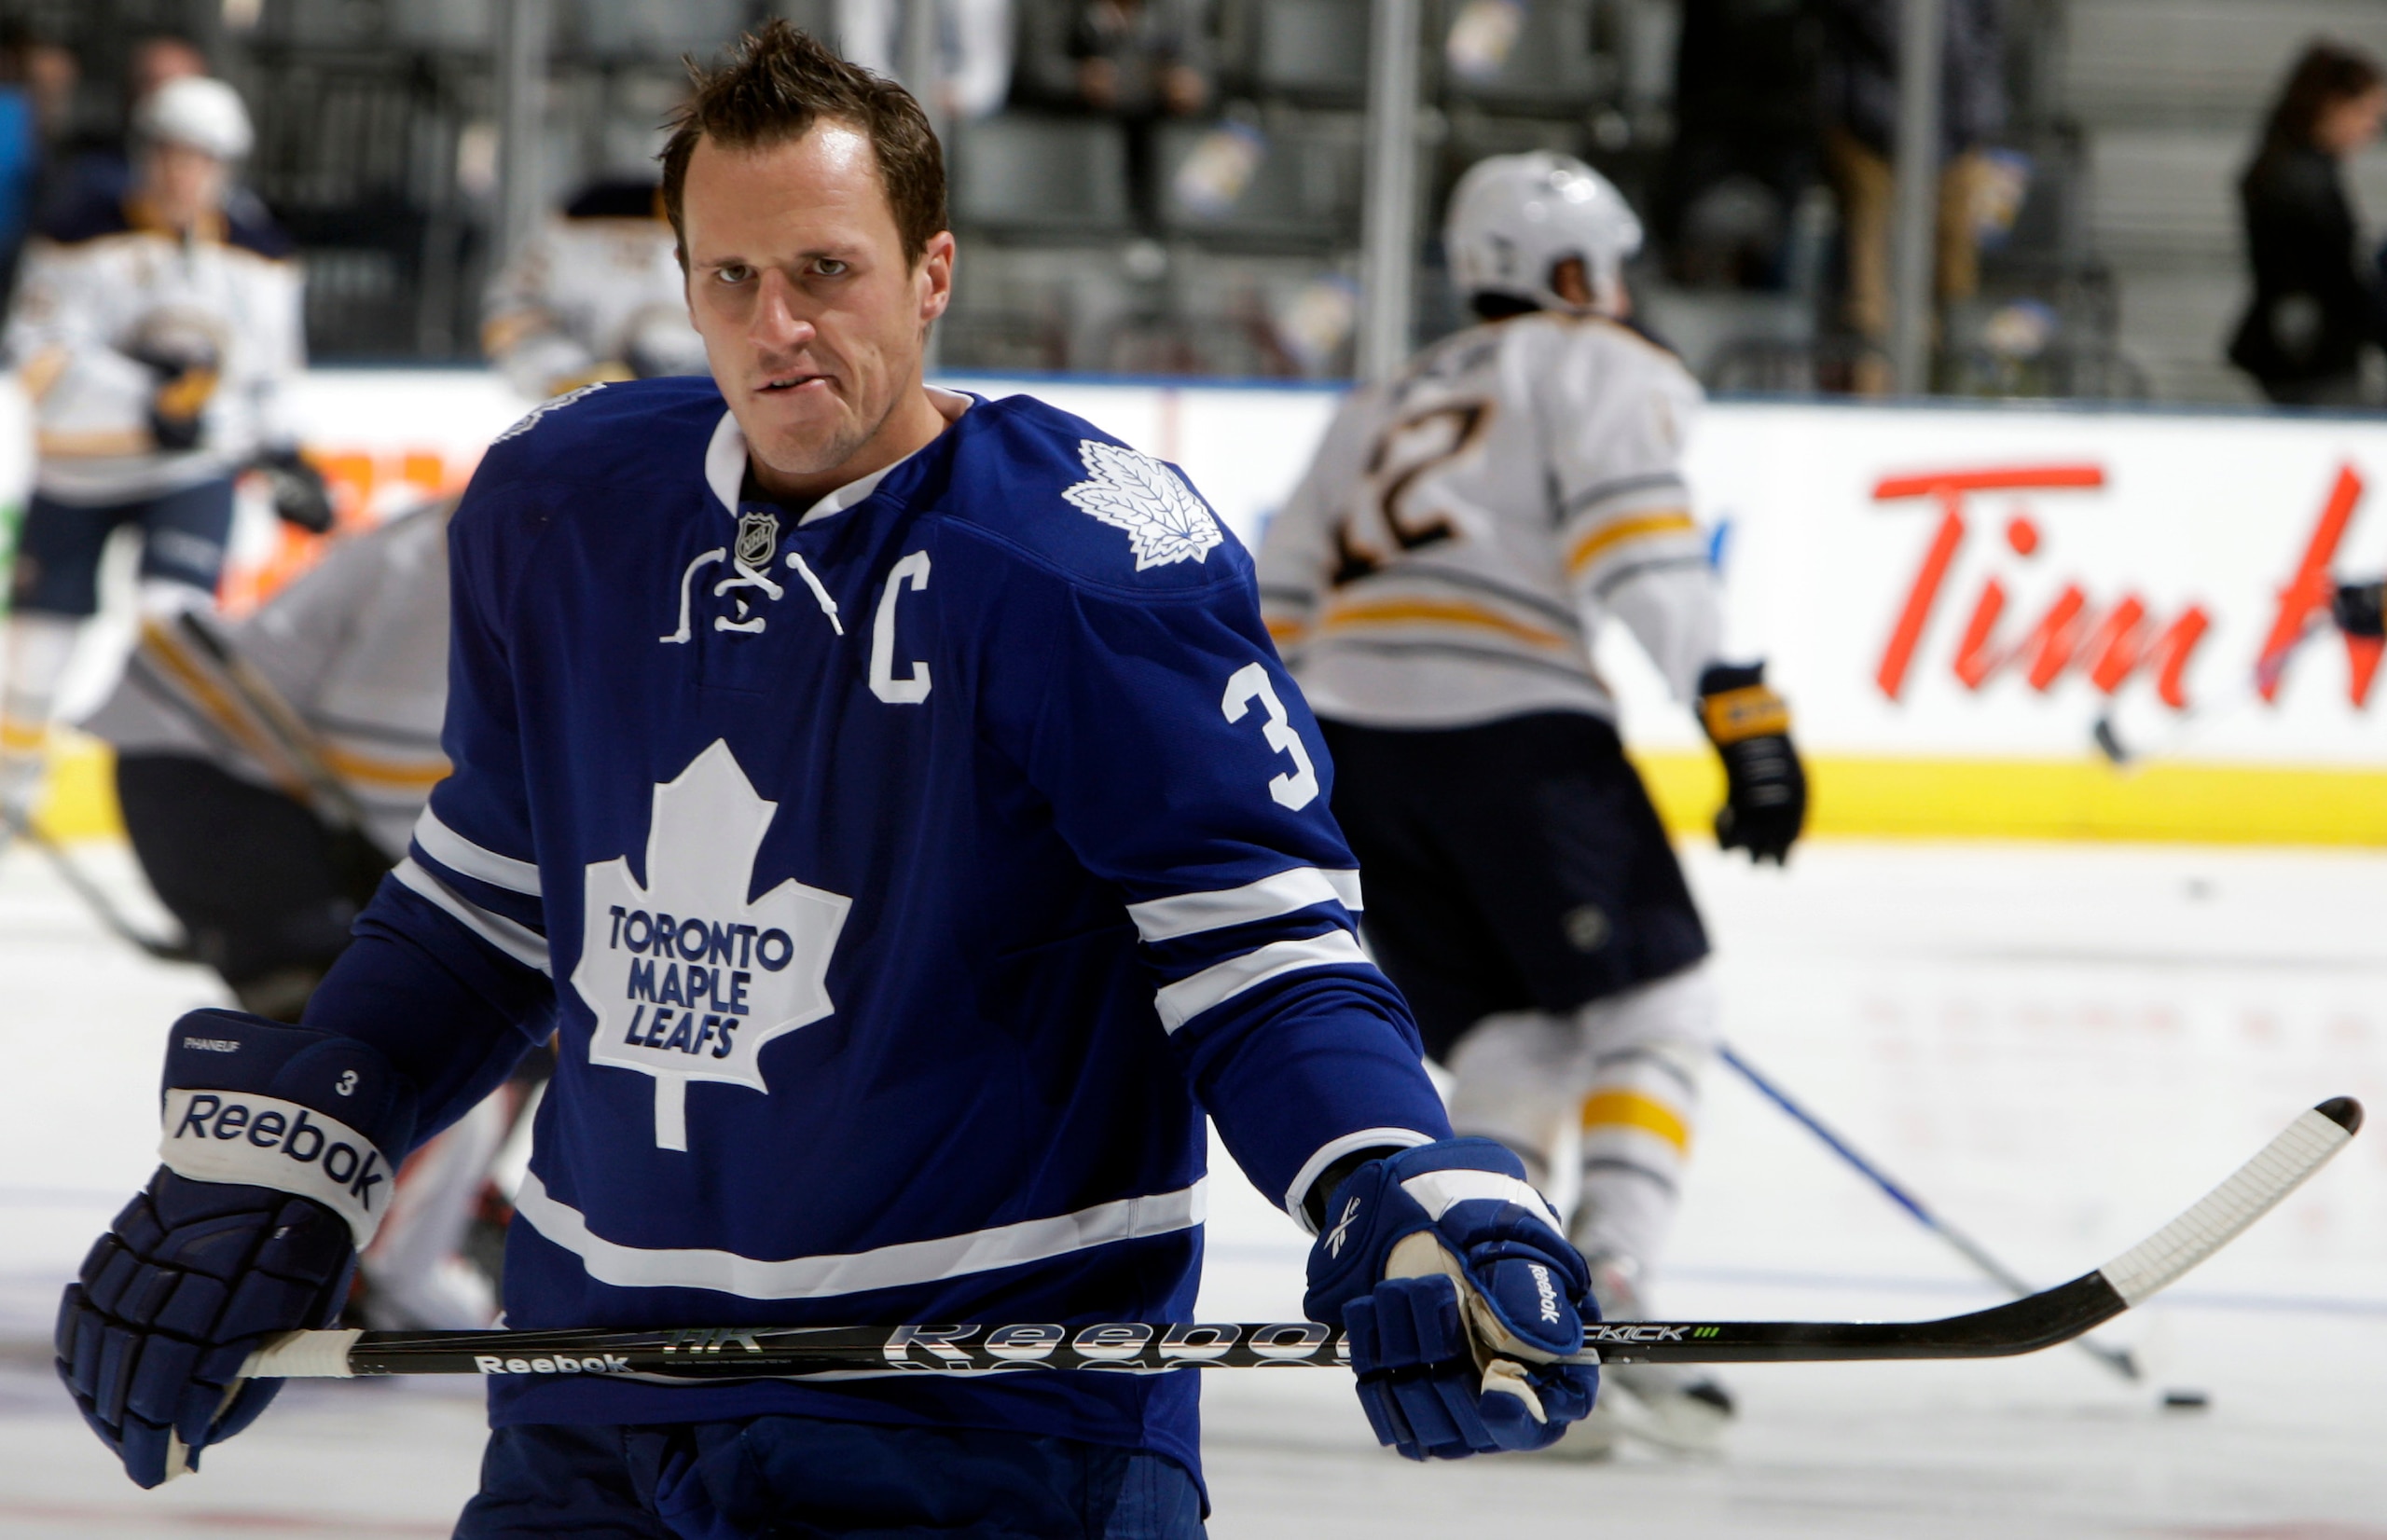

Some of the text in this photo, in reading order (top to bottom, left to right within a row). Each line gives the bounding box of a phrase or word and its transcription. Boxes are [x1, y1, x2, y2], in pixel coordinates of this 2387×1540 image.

[741, 525, 770, 556] NHL
[1871, 464, 2211, 708] Tim
[868, 549, 932, 705] C
[1221, 662, 1319, 812] 3
[609, 905, 794, 972] TORONTO
[627, 957, 752, 1016] MAPLE
[184, 1037, 241, 1053] PHANEUF
[623, 1004, 739, 1060] LEAFS
[335, 1069, 359, 1097] 3
[174, 1093, 385, 1213] Reebok
[1527, 1262, 1561, 1325] Reebok
[473, 1354, 634, 1375] Reebok
[883, 1323, 1351, 1361] Reebo
